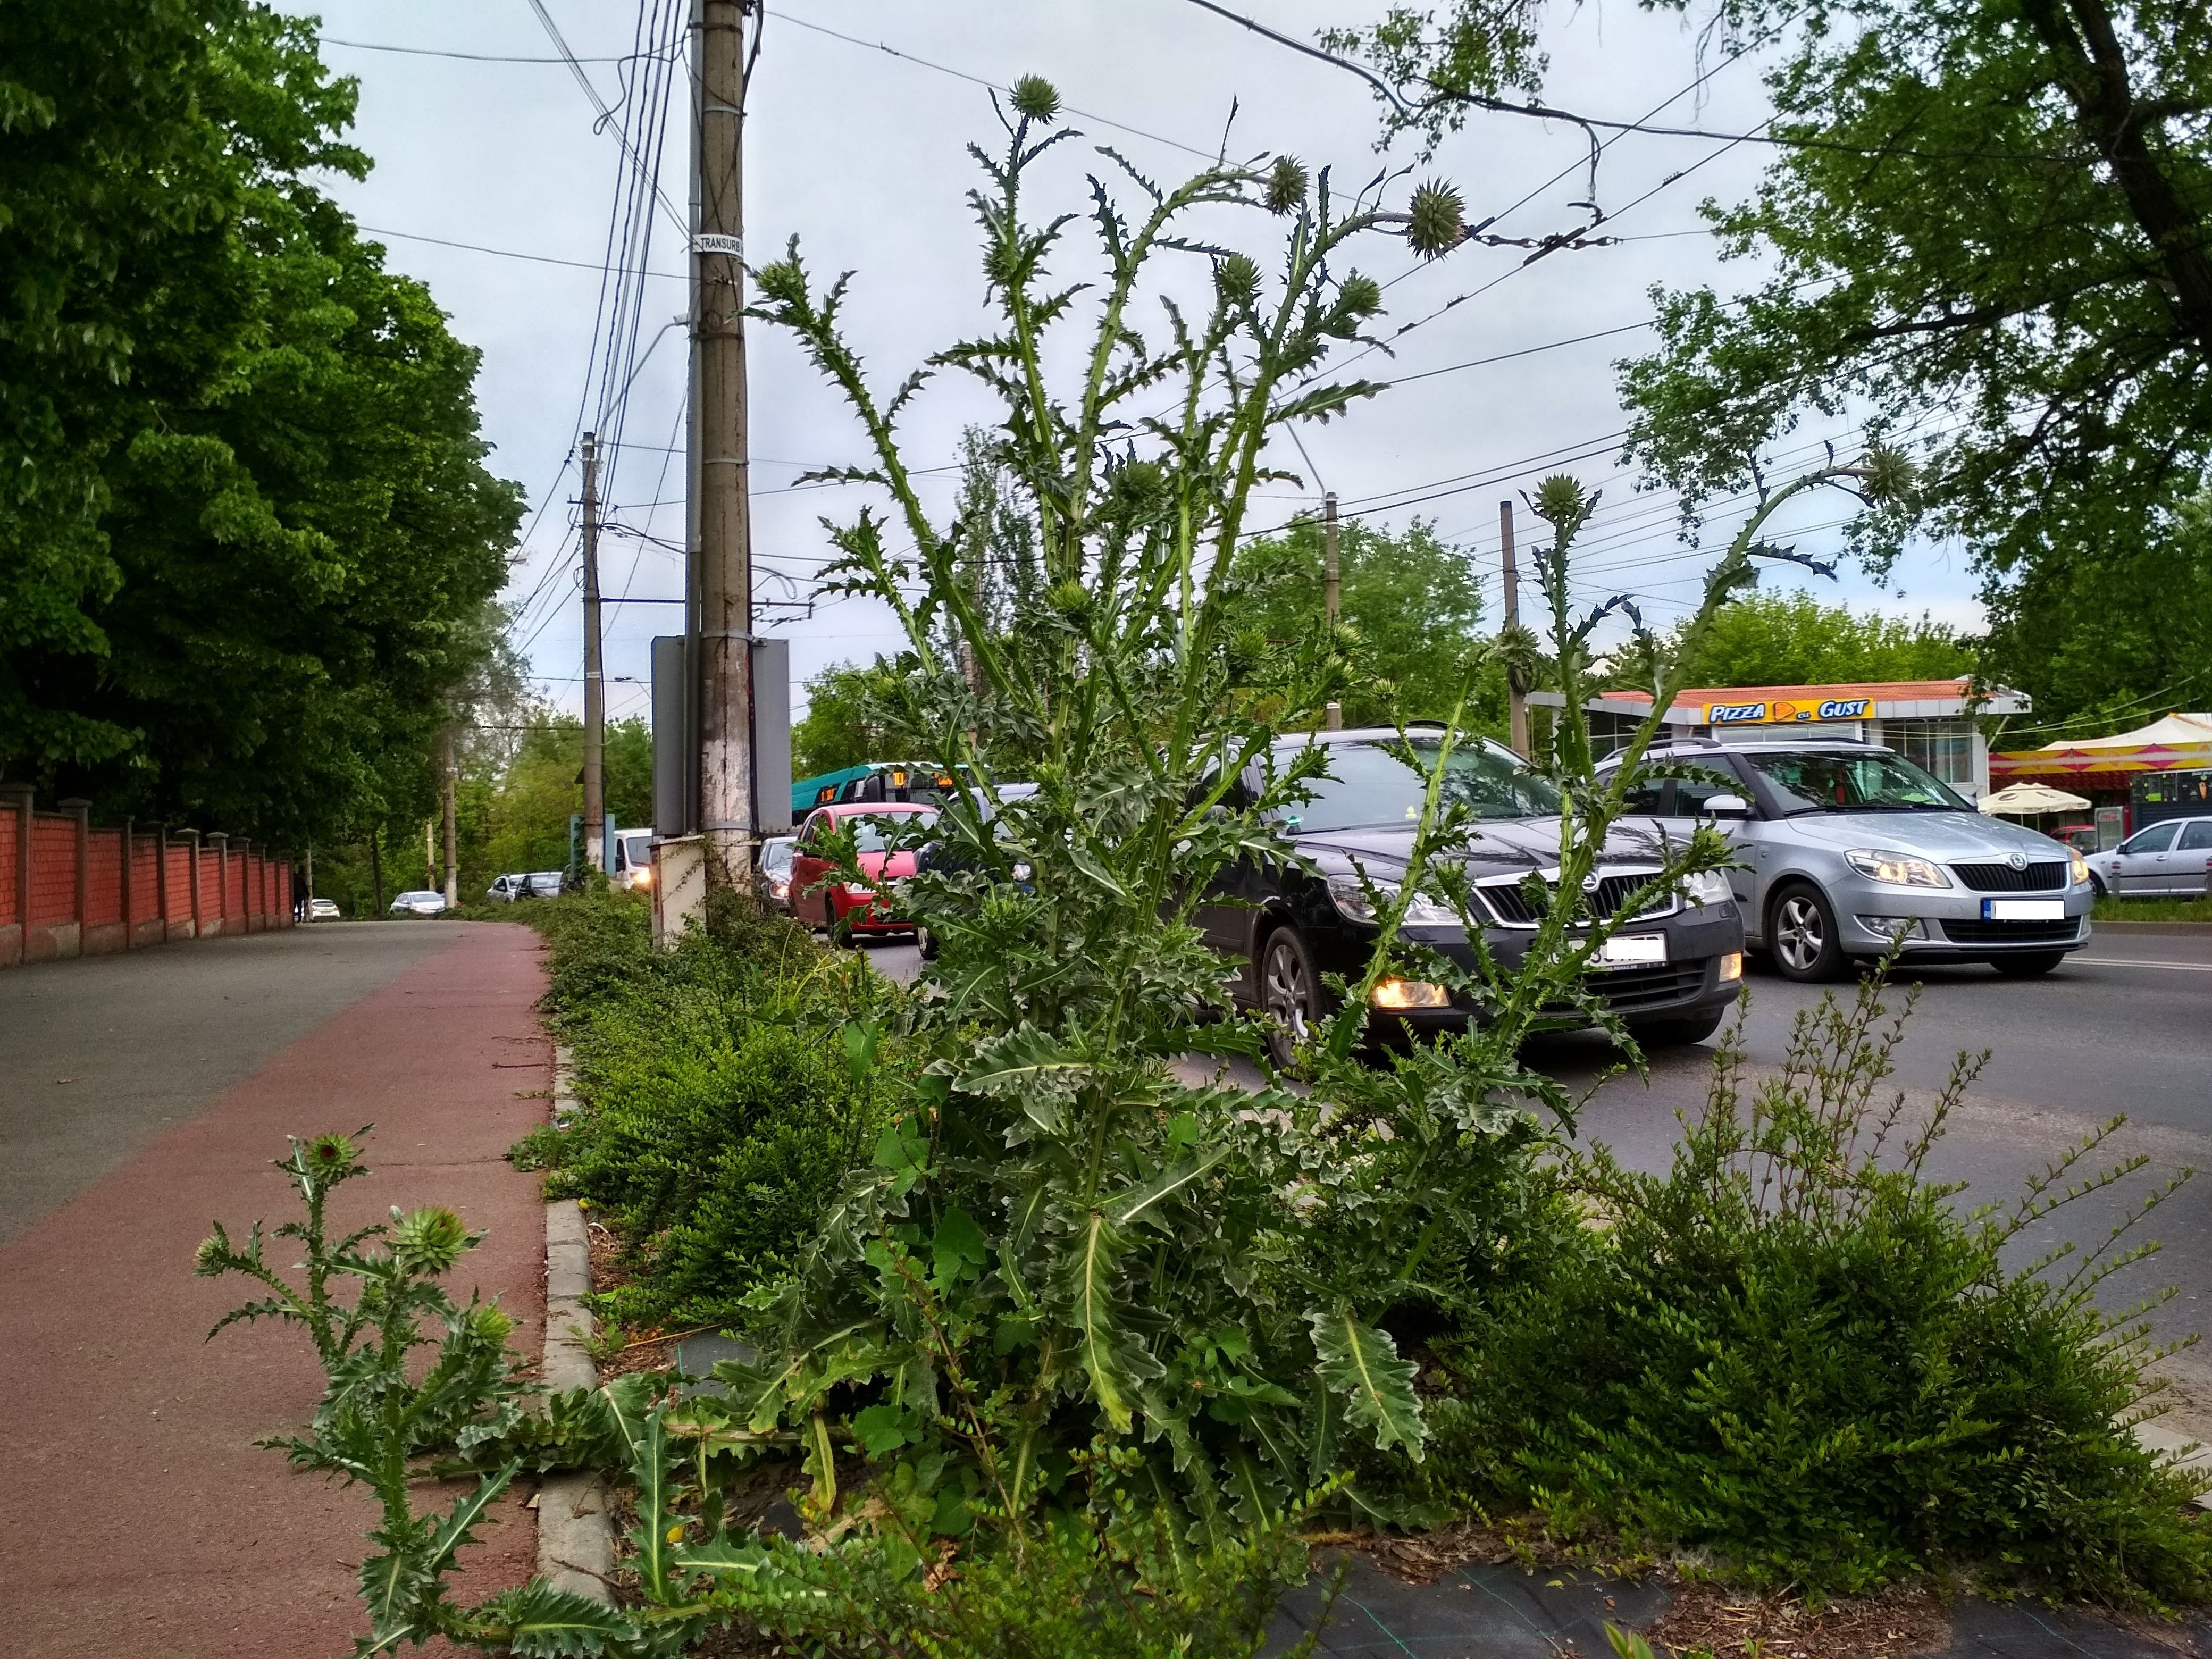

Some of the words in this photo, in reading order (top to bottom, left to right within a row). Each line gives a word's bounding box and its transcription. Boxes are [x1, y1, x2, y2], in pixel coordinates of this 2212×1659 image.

[700, 237, 740, 253] TRANSURB
[1710, 703, 1765, 722] PIZZA
[1819, 700, 1870, 718] GUST
